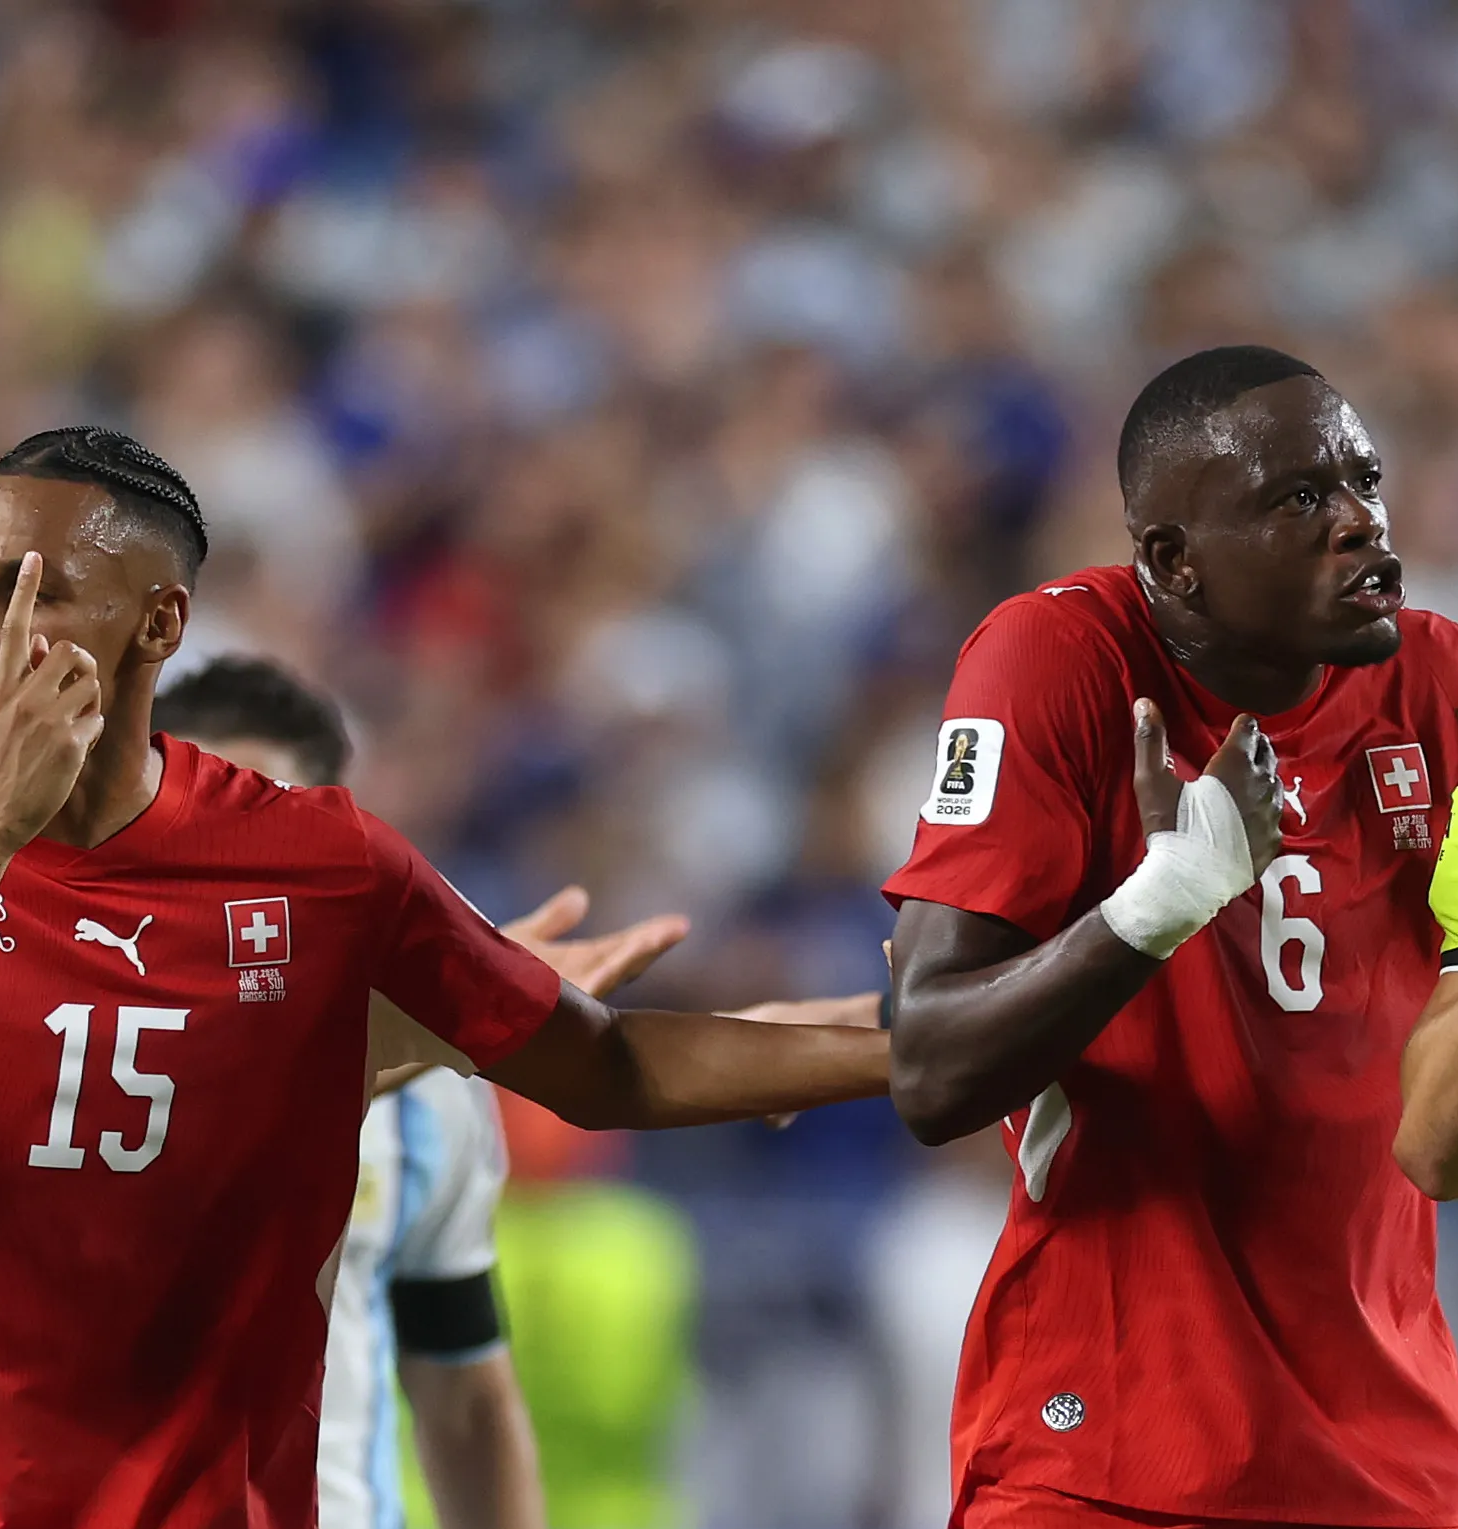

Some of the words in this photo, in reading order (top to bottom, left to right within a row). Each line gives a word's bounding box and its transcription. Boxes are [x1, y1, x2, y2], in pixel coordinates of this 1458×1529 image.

[946, 781, 966, 790] FIFA
[937, 797, 959, 805] WORLD
[960, 797, 973, 805] CUP
[936, 805, 971, 816] 2026
[1417, 837, 1432, 849] CITY
[1259, 855, 1326, 1013] 6
[239, 968, 280, 981] 11.07.2026
[267, 976, 285, 990] SUI
[239, 991, 268, 1003] KANSAS
[268, 990, 286, 1002] CITY
[28, 1002, 192, 1173] 15
